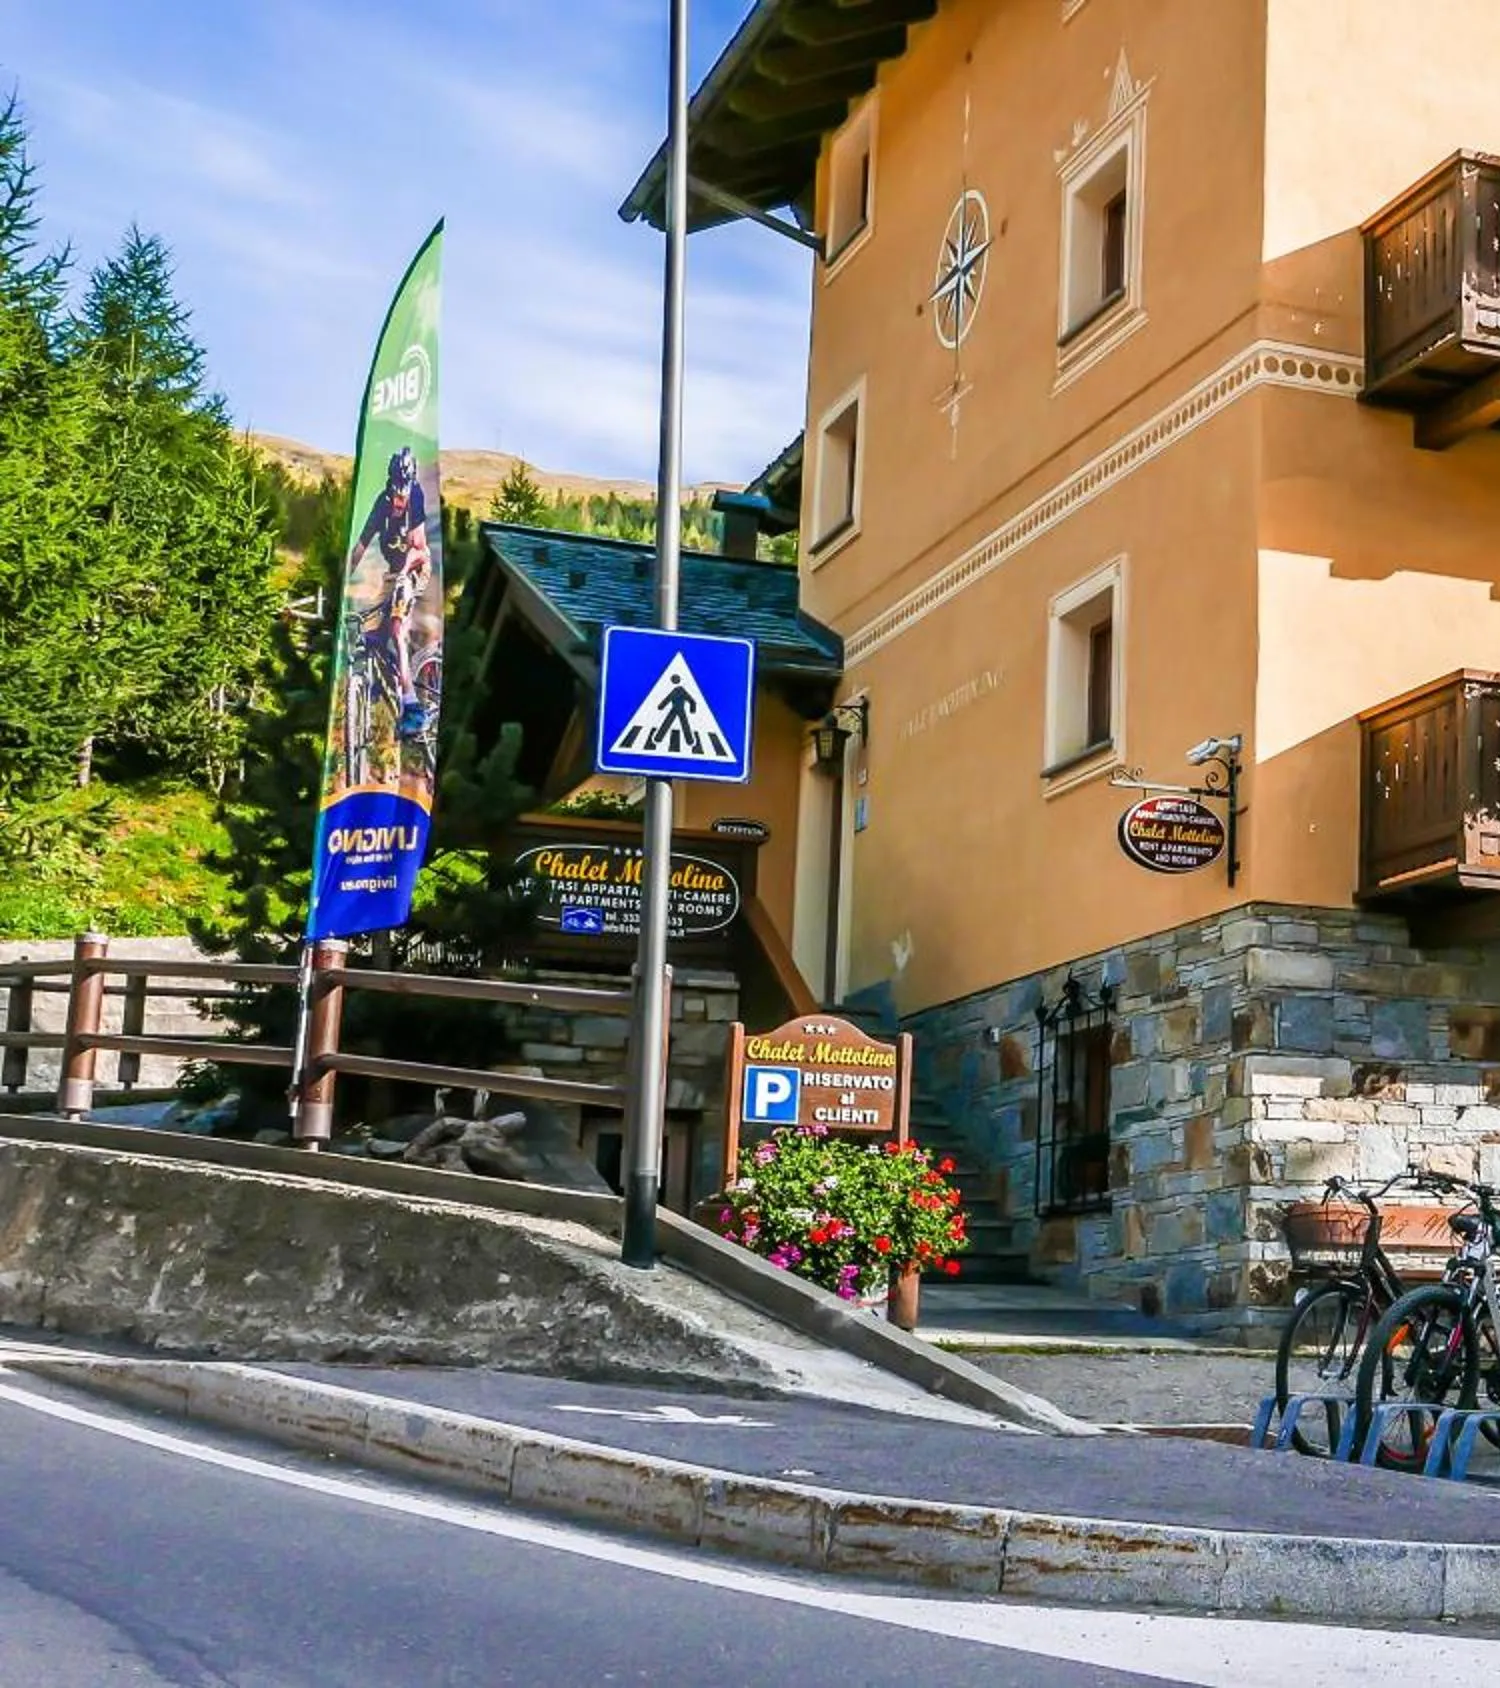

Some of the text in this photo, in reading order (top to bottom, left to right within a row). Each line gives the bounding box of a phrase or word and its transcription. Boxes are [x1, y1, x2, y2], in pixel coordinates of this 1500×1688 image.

[535, 851, 609, 881] Chalet
[677, 902, 723, 917] ROOMS
[747, 1036, 897, 1068] Chalet Mottolino
[804, 1071, 893, 1091] RISERVATO
[755, 1071, 792, 1118] P
[815, 1107, 879, 1124] CLIENTI
